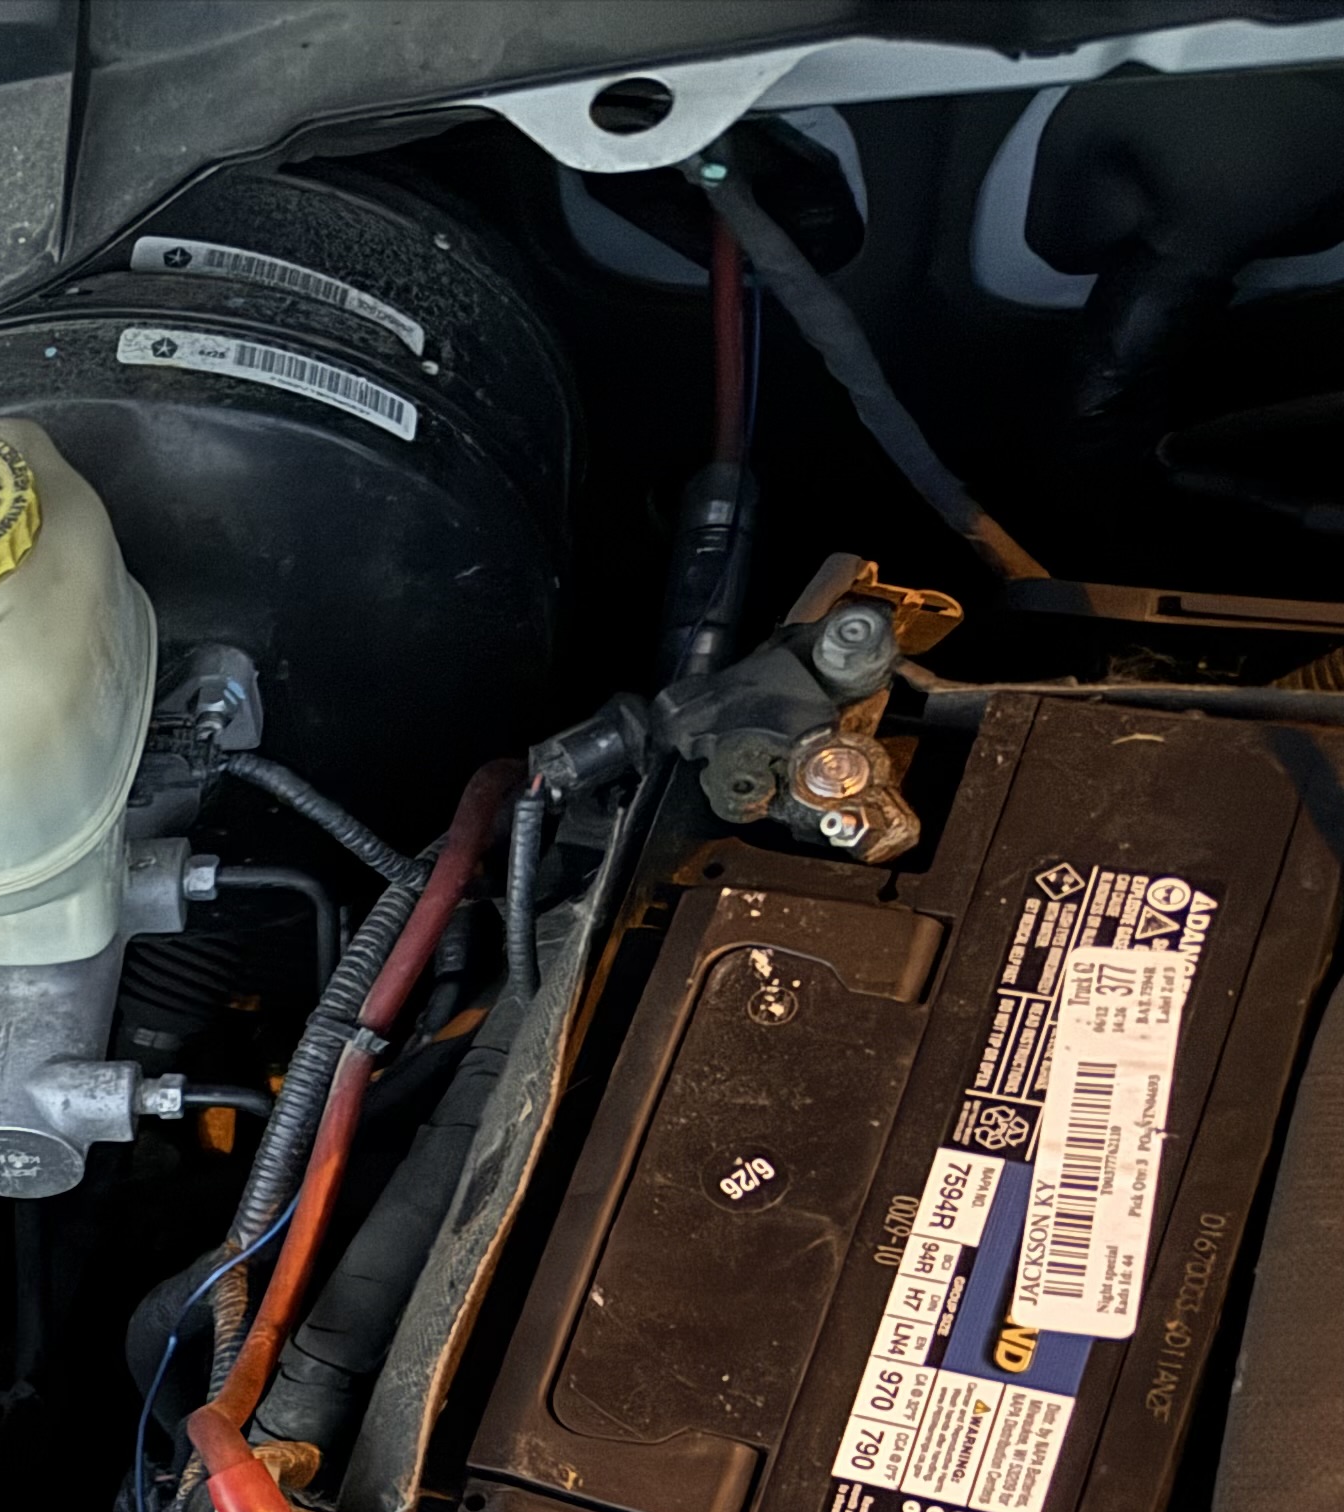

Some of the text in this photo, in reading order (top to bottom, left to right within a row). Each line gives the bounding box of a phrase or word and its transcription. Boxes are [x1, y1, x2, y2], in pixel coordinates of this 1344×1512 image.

[1067, 976, 1092, 1005] Truck
[1095, 963, 1135, 996] 377
[720, 1157, 776, 1200] 6/26
[977, 1167, 995, 1191] NAPA
[930, 1163, 971, 1228] 7594R
[1127, 1194, 1143, 1217] Pick
[874, 1195, 918, 1268] 01-6700
[1019, 1179, 1055, 1304] JACKSON KY
[914, 1242, 939, 1273] 94R
[1096, 1244, 1118, 1312] Night special
[903, 1287, 932, 1311] H7
[926, 1294, 941, 1311] DIN
[937, 1275, 965, 1336] GROUP SIZE
[888, 1322, 913, 1355] LN4
[914, 1335, 927, 1350] EN
[870, 1370, 902, 1410] 970
[914, 1373, 928, 1386] CA
[851, 1429, 884, 1469] 790
[893, 1432, 909, 1451] CCA
[951, 1416, 981, 1482] WARNING:
[1031, 1440, 1049, 1465] NAPA
